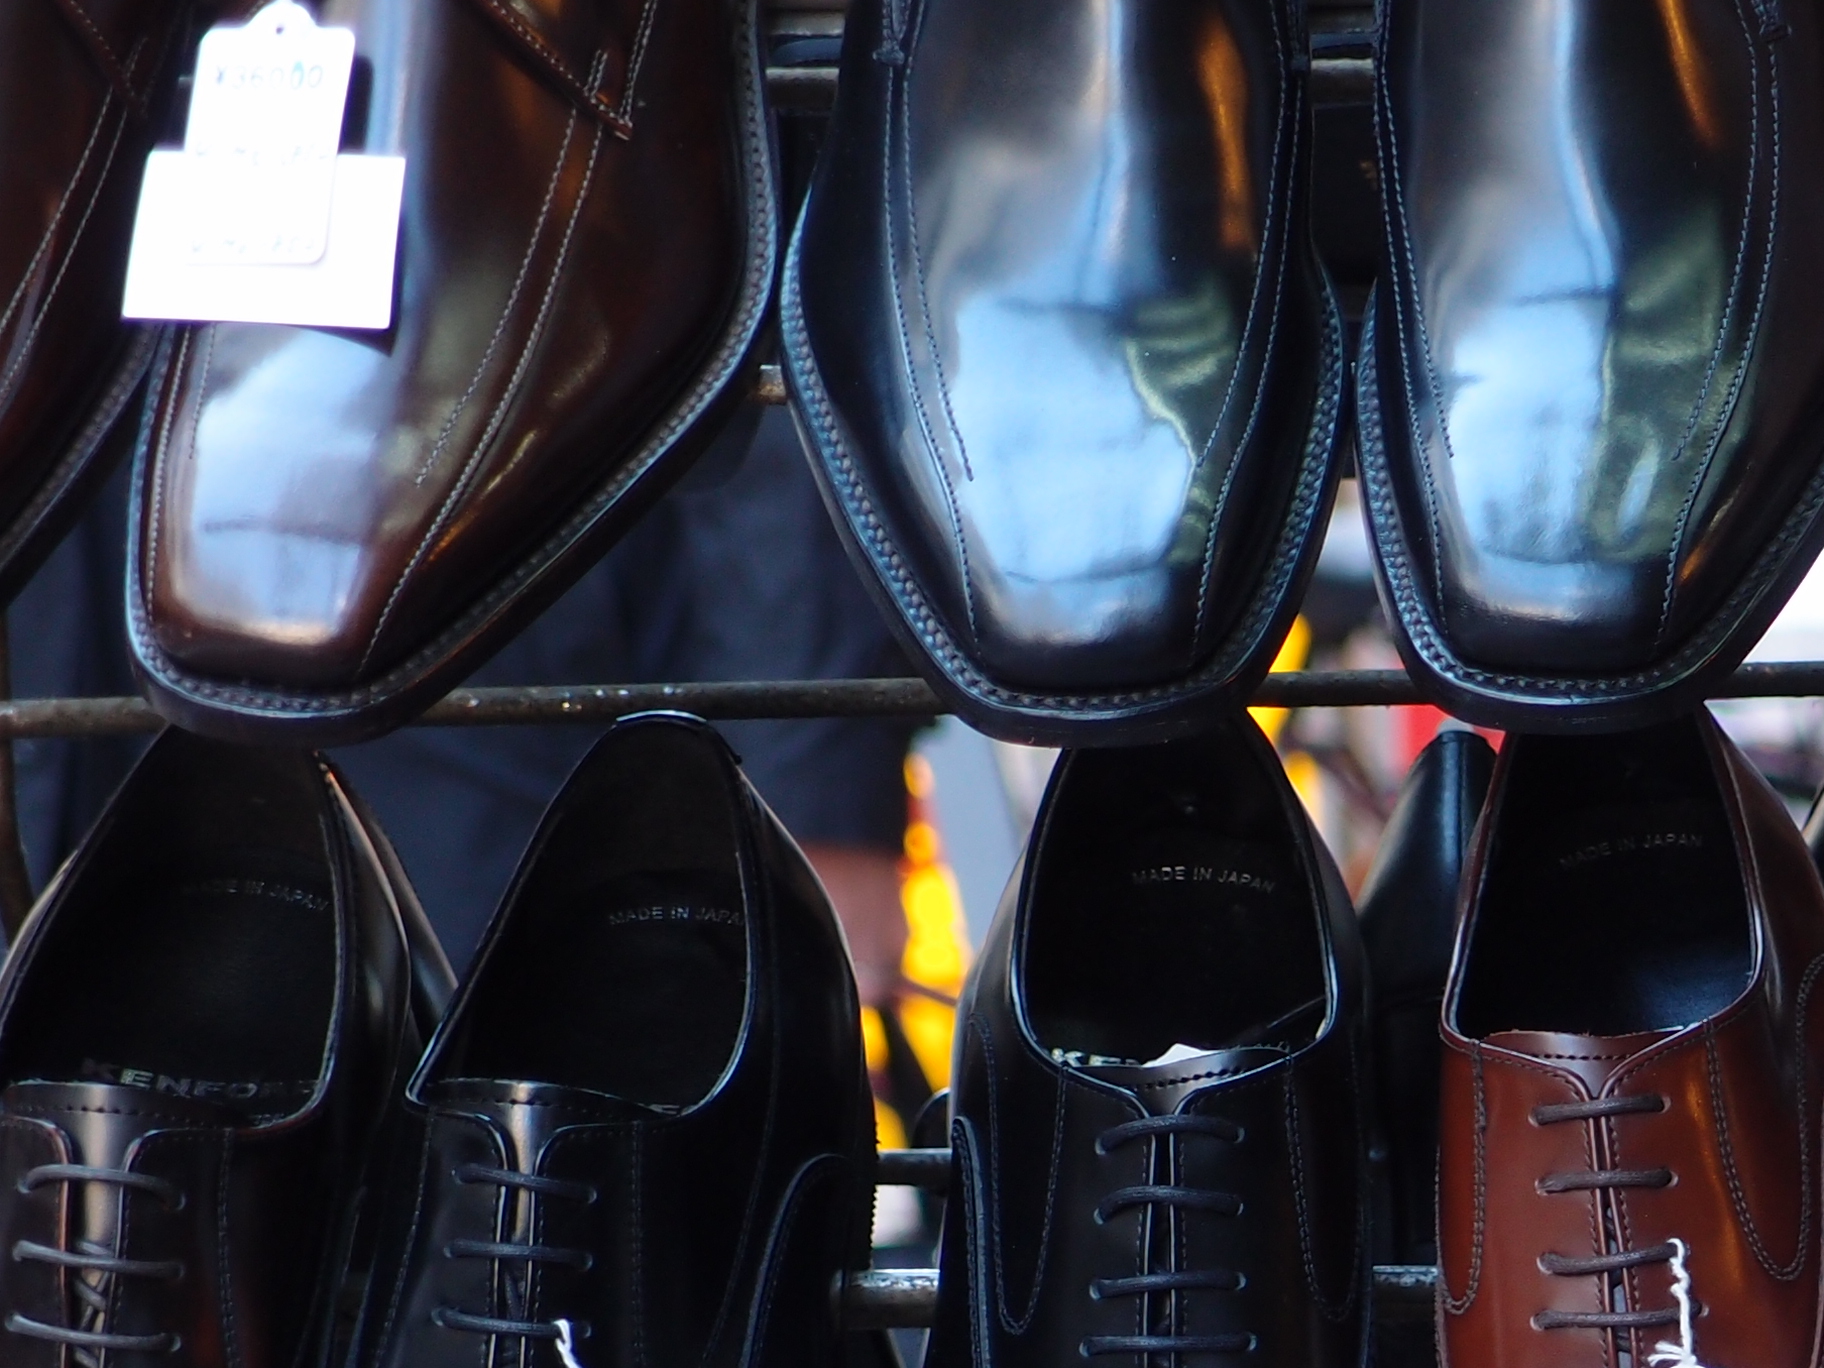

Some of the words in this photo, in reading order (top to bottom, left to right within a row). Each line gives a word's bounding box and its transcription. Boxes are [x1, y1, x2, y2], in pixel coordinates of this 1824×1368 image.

[1559, 841, 1612, 871] MADE
[1618, 836, 1636, 852] IN
[1642, 832, 1703, 849] JAPAN
[1132, 865, 1186, 885] MADE
[1193, 866, 1212, 881] IN
[1217, 869, 1276, 894] JAPAN
[269, 884, 329, 911] JAPAN
[608, 906, 664, 925] MADE
[671, 906, 689, 921] IN
[695, 907, 745, 926] JAPA
